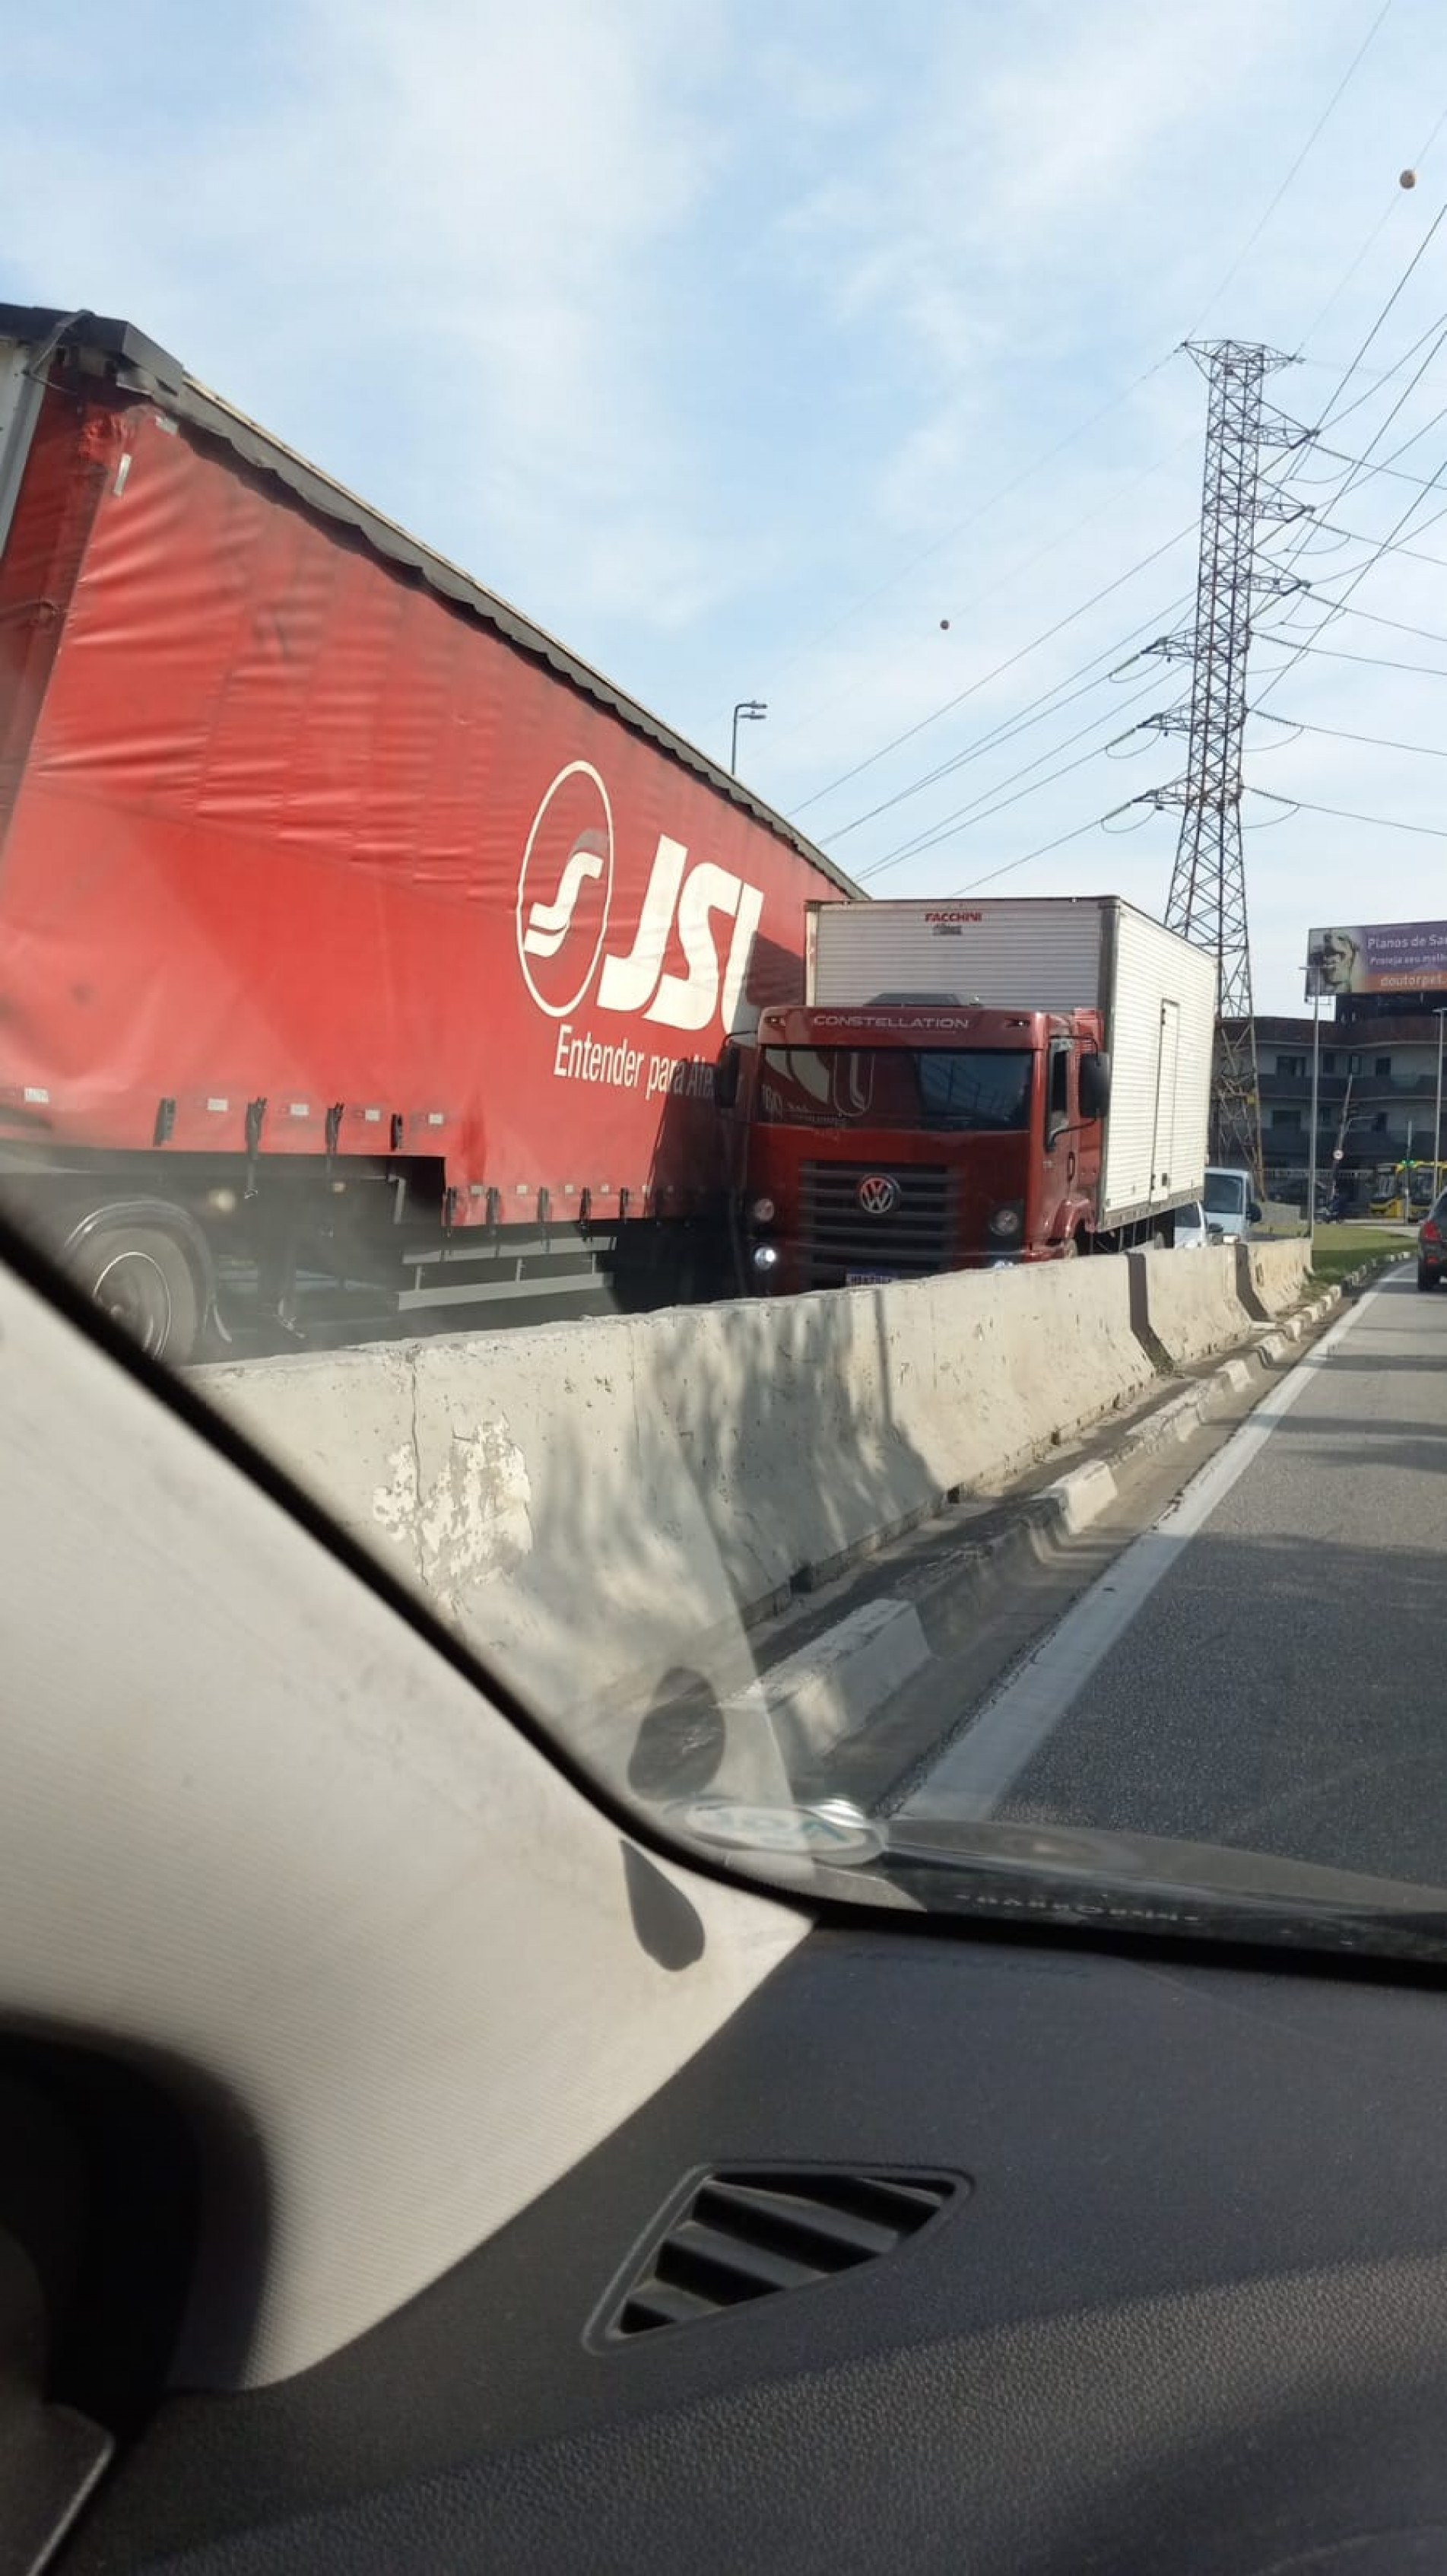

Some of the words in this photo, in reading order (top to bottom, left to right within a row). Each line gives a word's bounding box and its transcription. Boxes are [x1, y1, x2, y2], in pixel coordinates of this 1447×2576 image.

[925, 912, 982, 923] FACCHINI
[1367, 937, 1409, 950] Planos
[1411, 934, 1426, 947] de
[1429, 933, 1447, 947] Sa
[814, 1016, 969, 1029] CONSTELLATION
[553, 1024, 645, 1088] Entender
[645, 1054, 685, 1101] para
[685, 1054, 716, 1097] Ate
